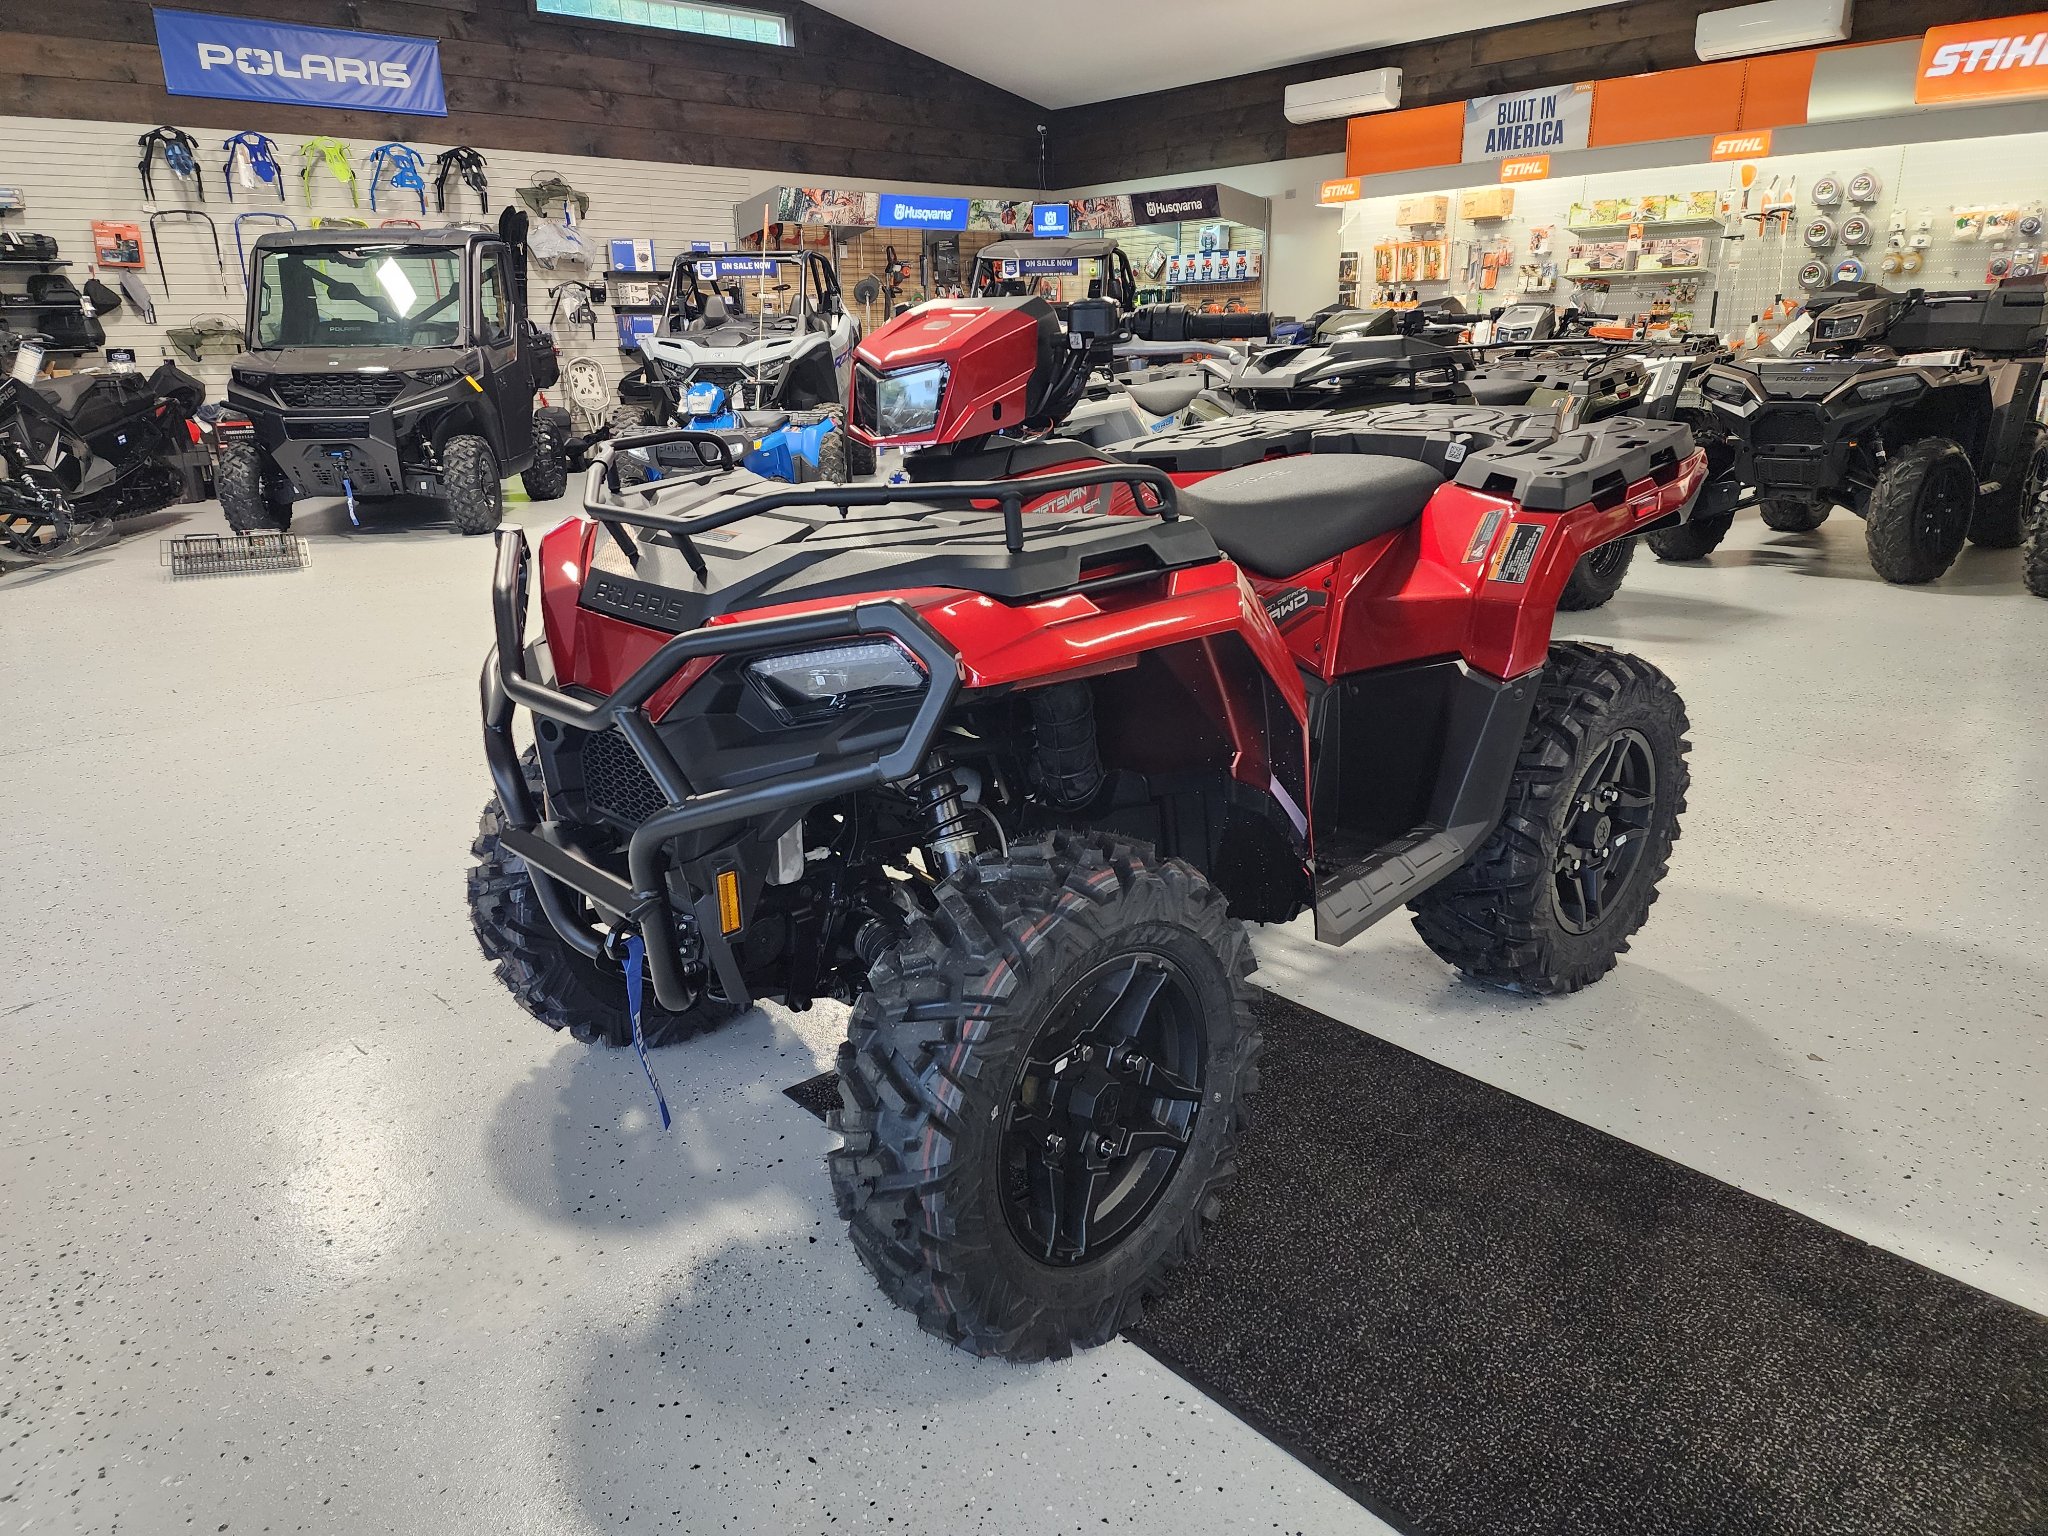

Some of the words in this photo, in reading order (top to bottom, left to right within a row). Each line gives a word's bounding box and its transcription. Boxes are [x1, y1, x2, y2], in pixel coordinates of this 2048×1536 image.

[197, 42, 412, 89] POLARIS
[1498, 98, 1537, 126] BUILT
[1540, 95, 1557, 120] IN
[1485, 119, 1564, 154] AMERICA
[1714, 137, 1764, 155] STIHL
[1502, 161, 1543, 178] STIHL
[1322, 182, 1356, 197] STIHL
[905, 205, 952, 222] Husqvarna
[1156, 199, 1203, 215] Husqvarna
[721, 262, 732, 270] ON
[733, 262, 753, 270] SALE
[754, 261, 771, 270] NOW
[1059, 259, 1073, 267] NOW
[592, 582, 684, 622] POLARIS
[1269, 593, 1309, 619] AWD
[633, 1011, 663, 1103] POLARIS
